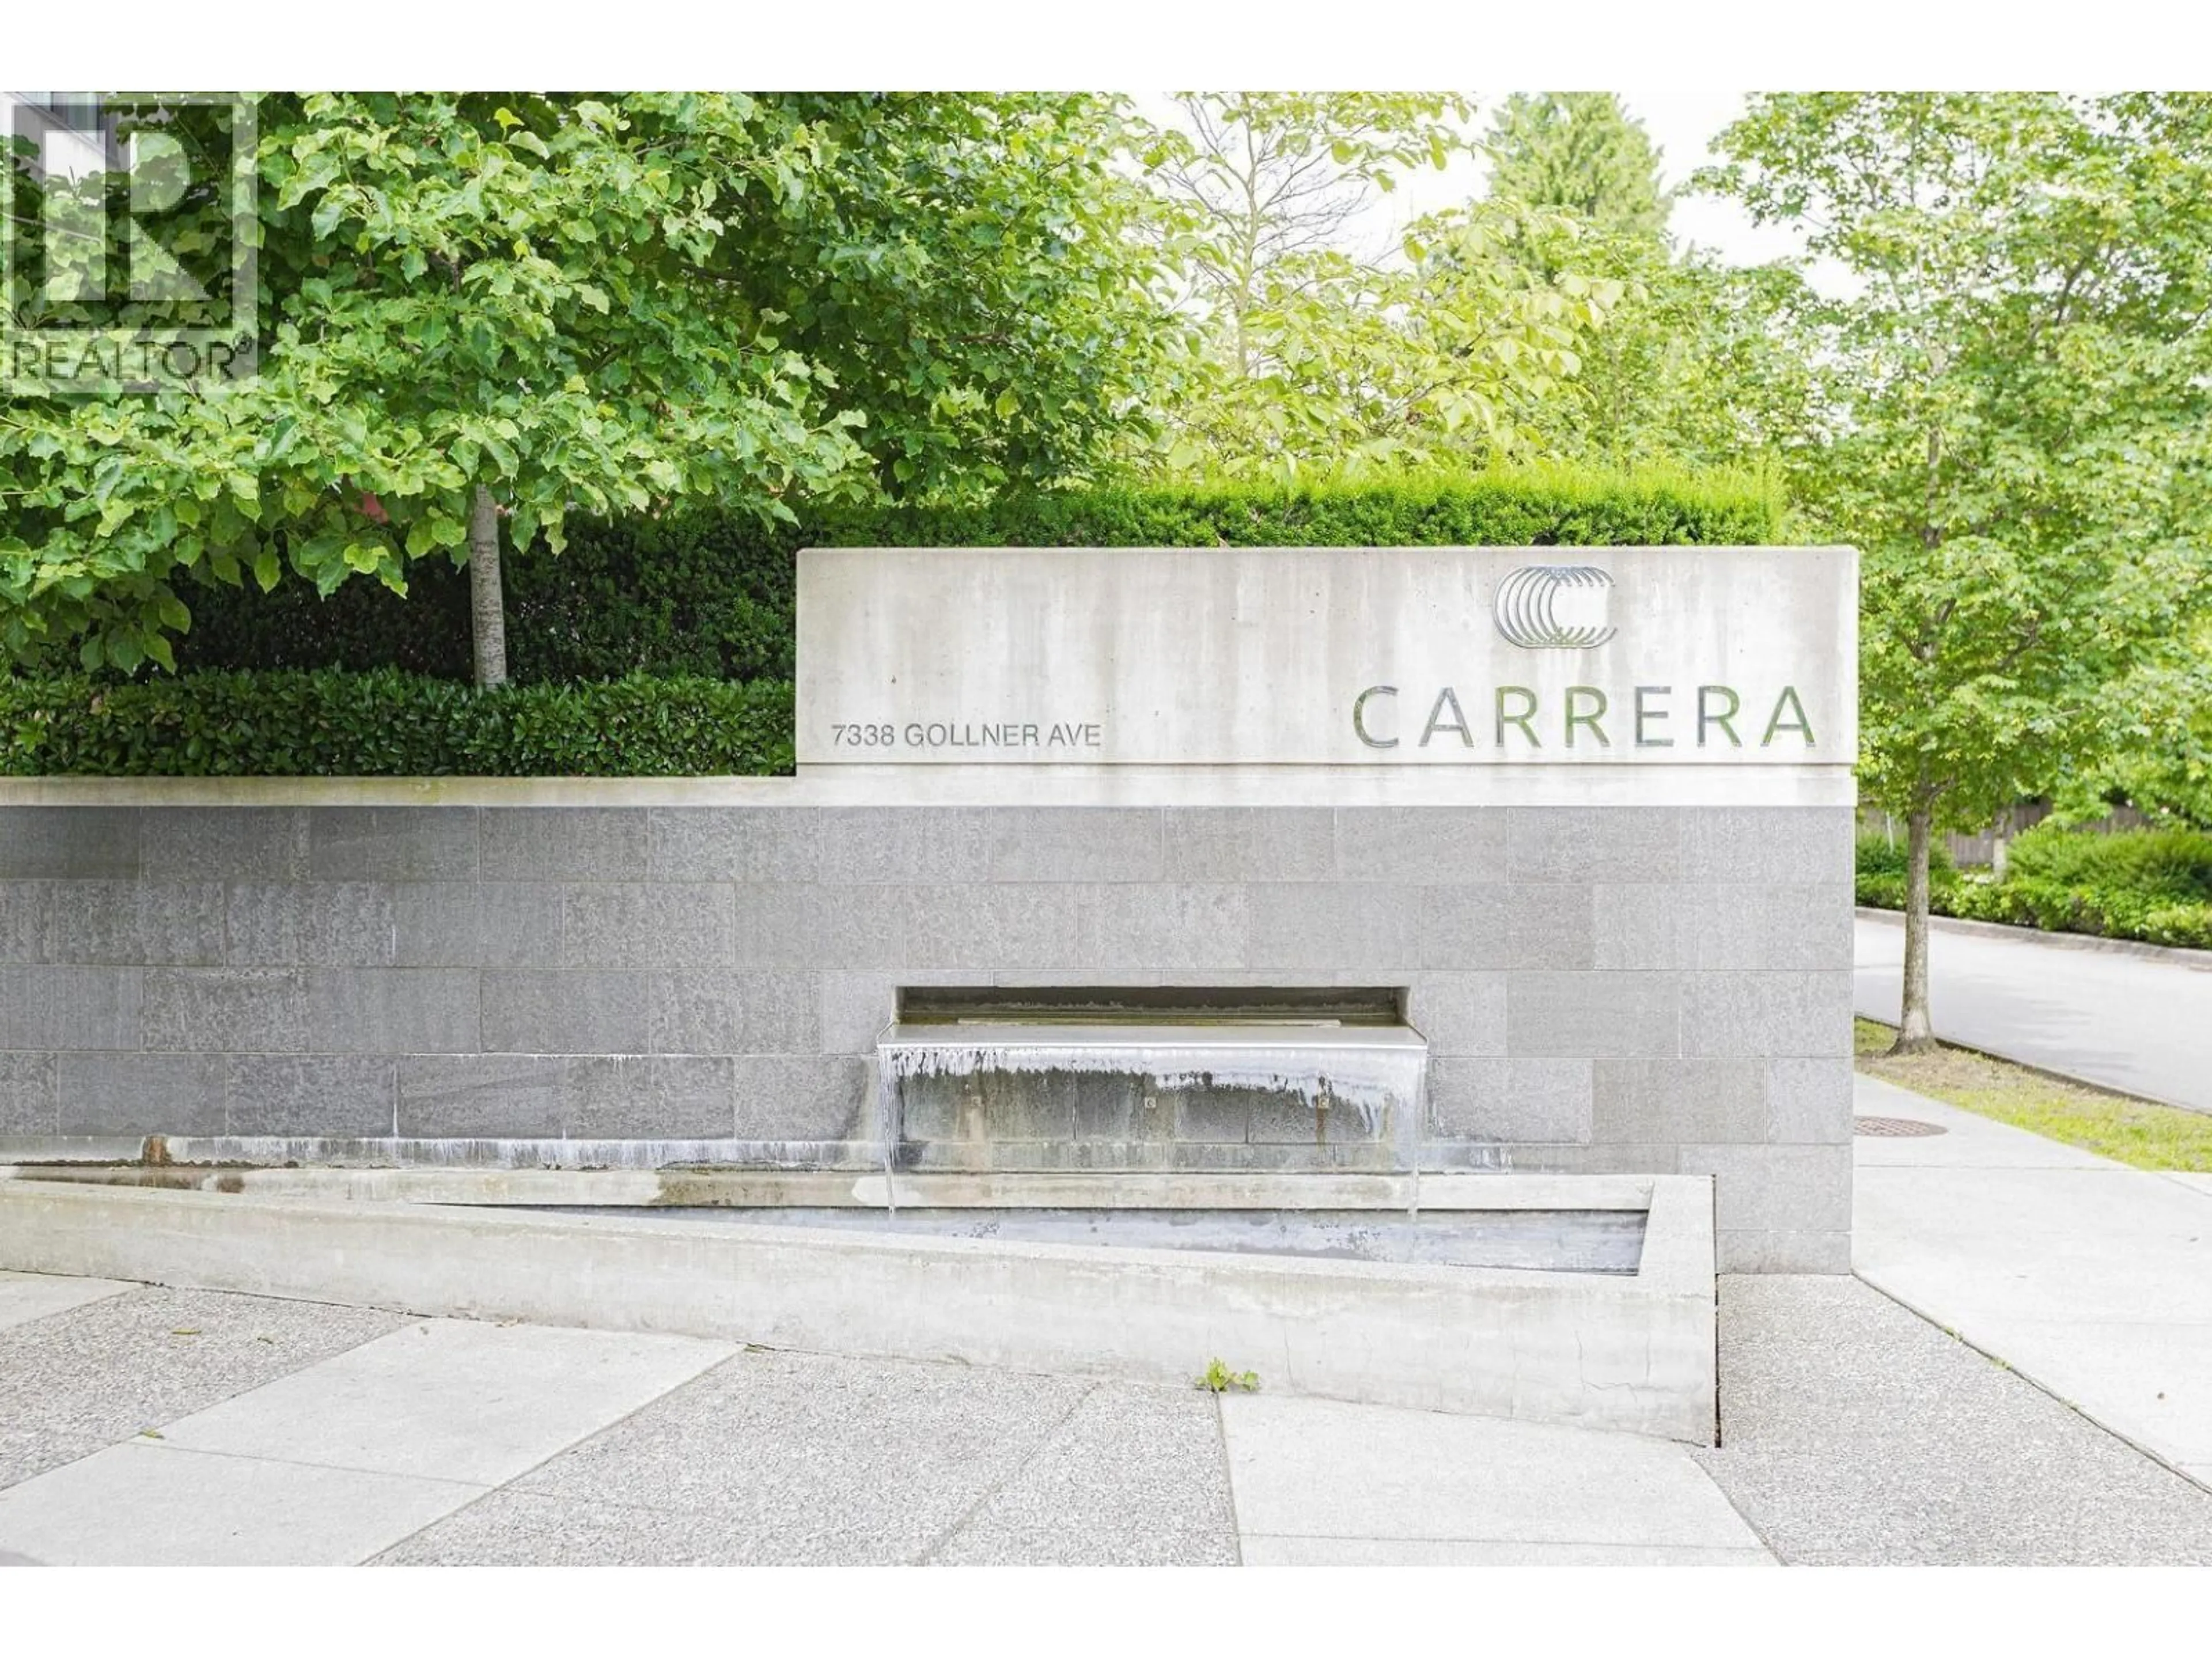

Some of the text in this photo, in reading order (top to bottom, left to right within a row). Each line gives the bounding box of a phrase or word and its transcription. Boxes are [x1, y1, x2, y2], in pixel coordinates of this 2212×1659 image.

[831, 723, 1101, 747] 7338 GOLLNER AVE
[1353, 685, 1816, 748] CARRERA
